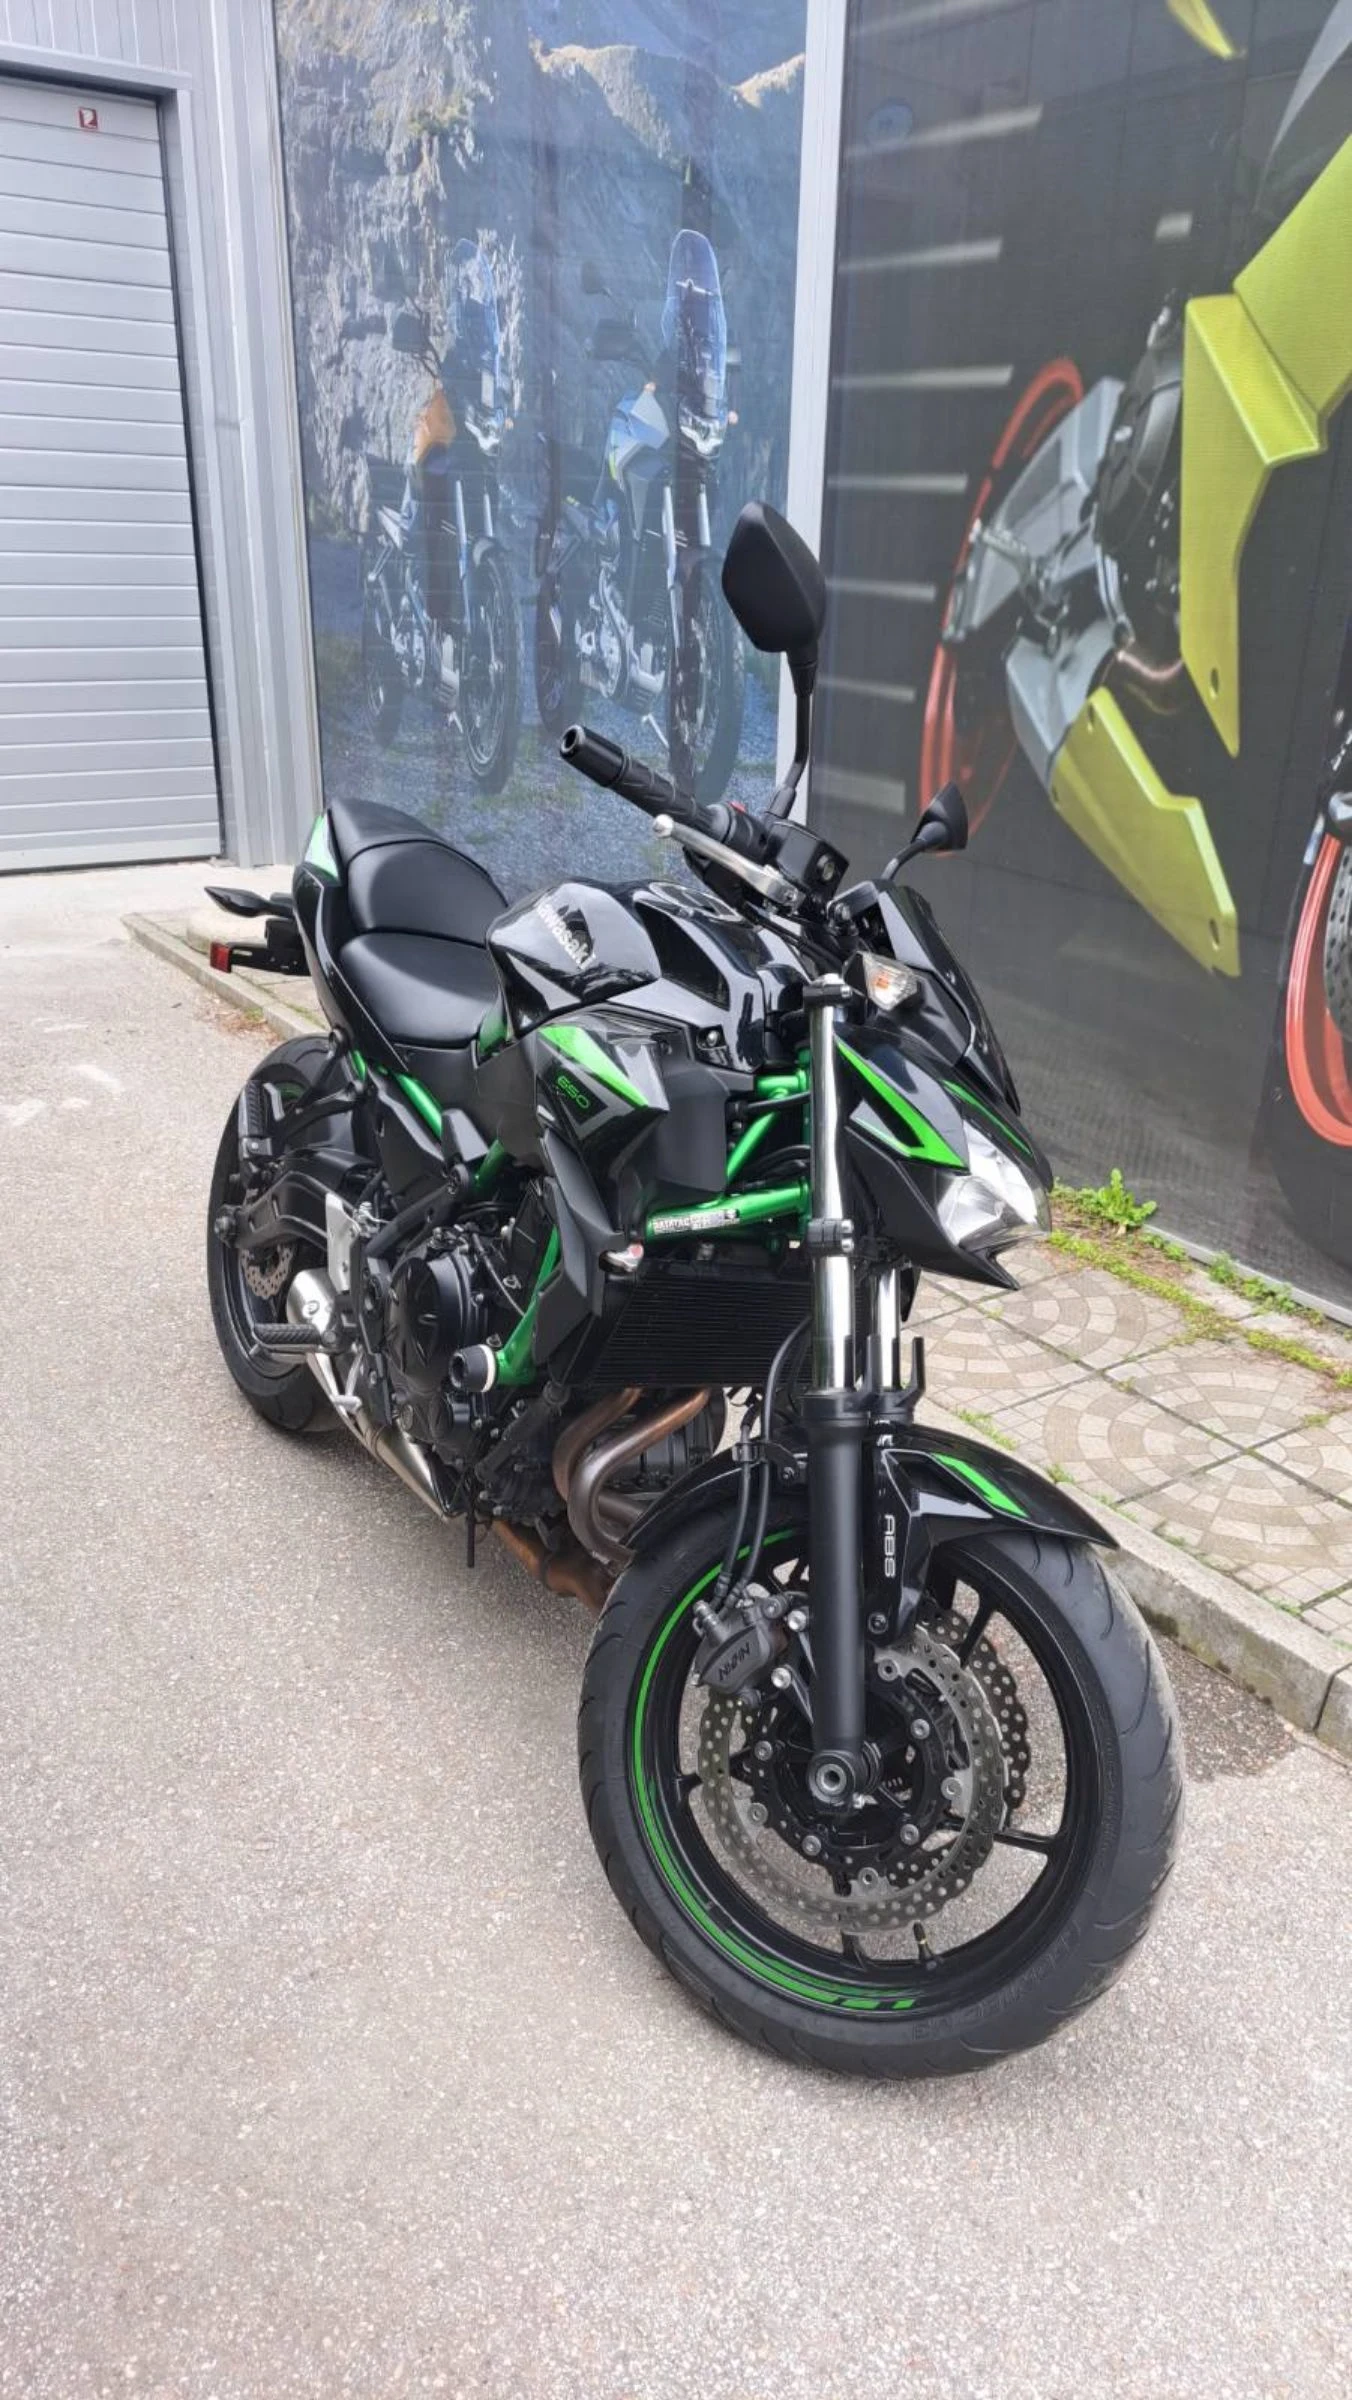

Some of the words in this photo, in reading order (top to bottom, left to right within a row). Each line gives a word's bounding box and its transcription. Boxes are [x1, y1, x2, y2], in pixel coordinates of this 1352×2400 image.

[535, 899, 596, 970] awasaki
[557, 1076, 589, 1108] 650
[884, 1514, 896, 1578] ABS
